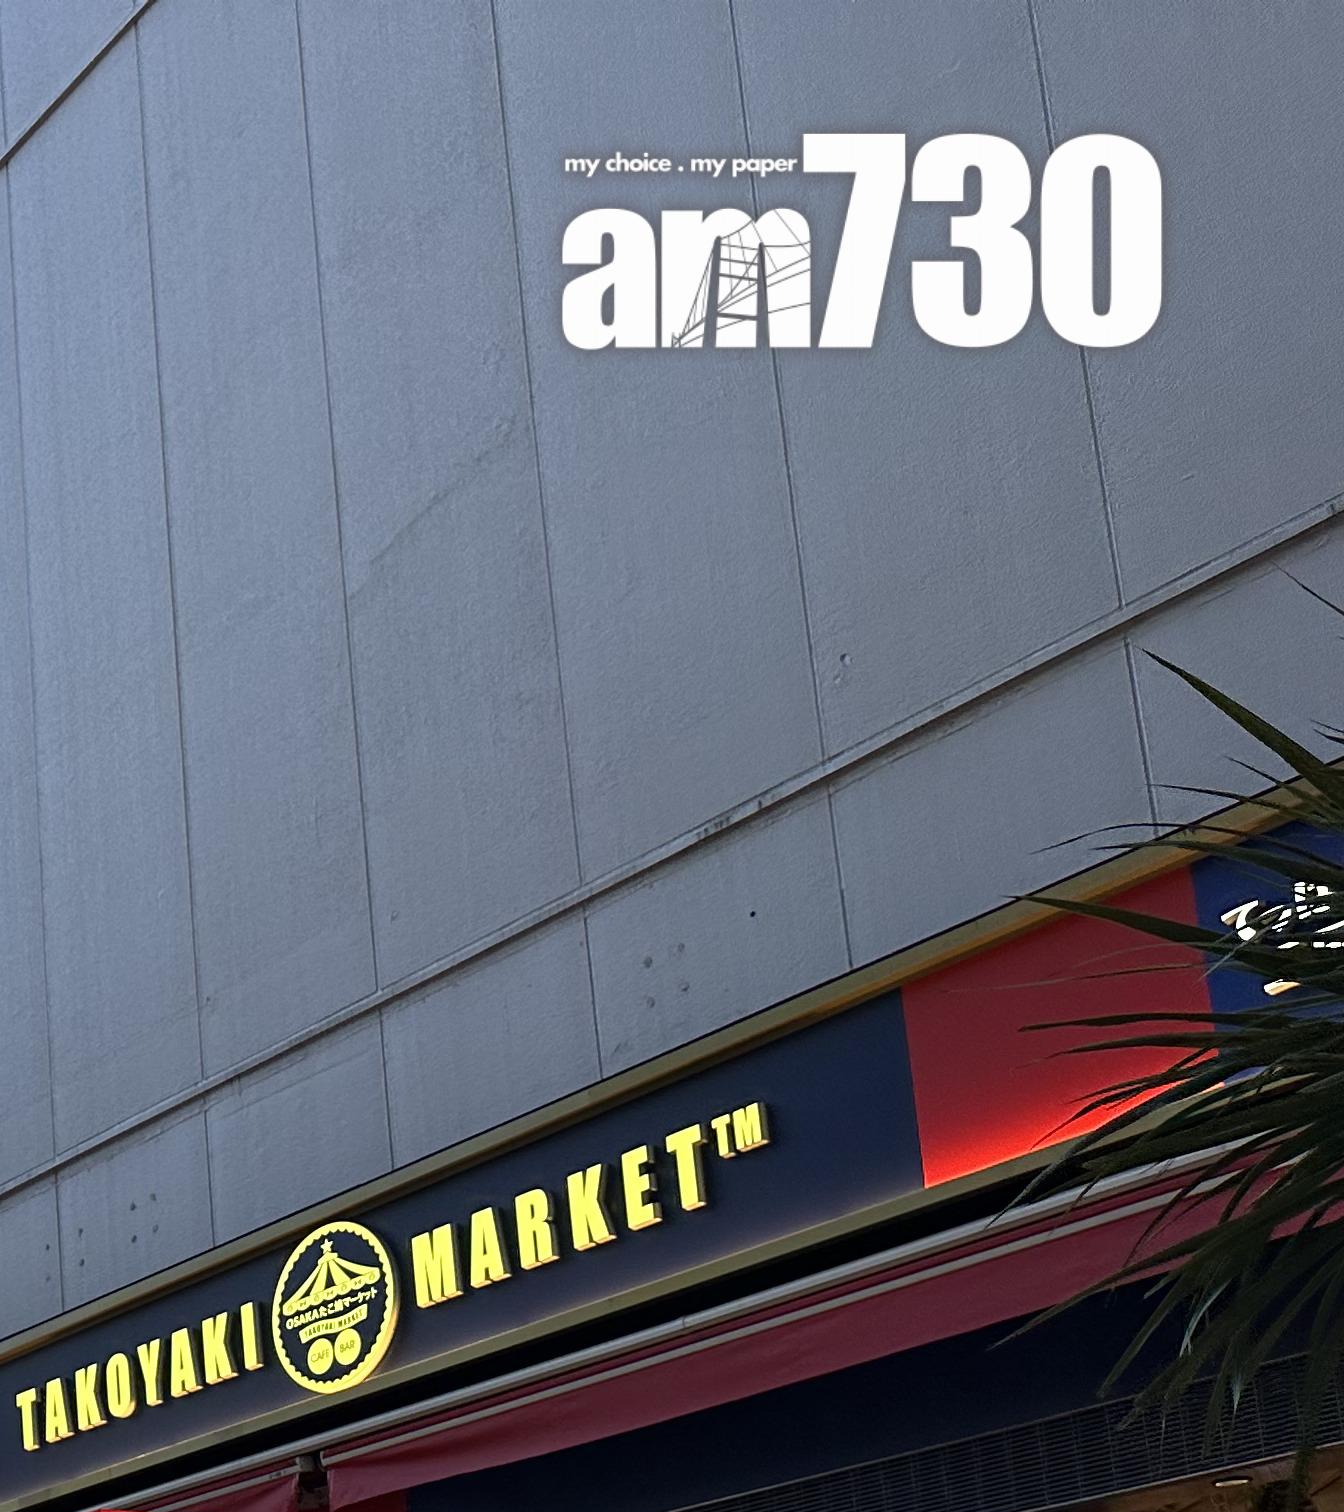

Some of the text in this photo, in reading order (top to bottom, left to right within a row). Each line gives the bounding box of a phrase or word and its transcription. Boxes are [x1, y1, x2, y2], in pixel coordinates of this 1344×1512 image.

[15, 1302, 264, 1452] TAKOYAKI
[410, 1123, 712, 1309] MARKET
[339, 1338, 356, 1352] BAR
[310, 1348, 331, 1364] CAFE
